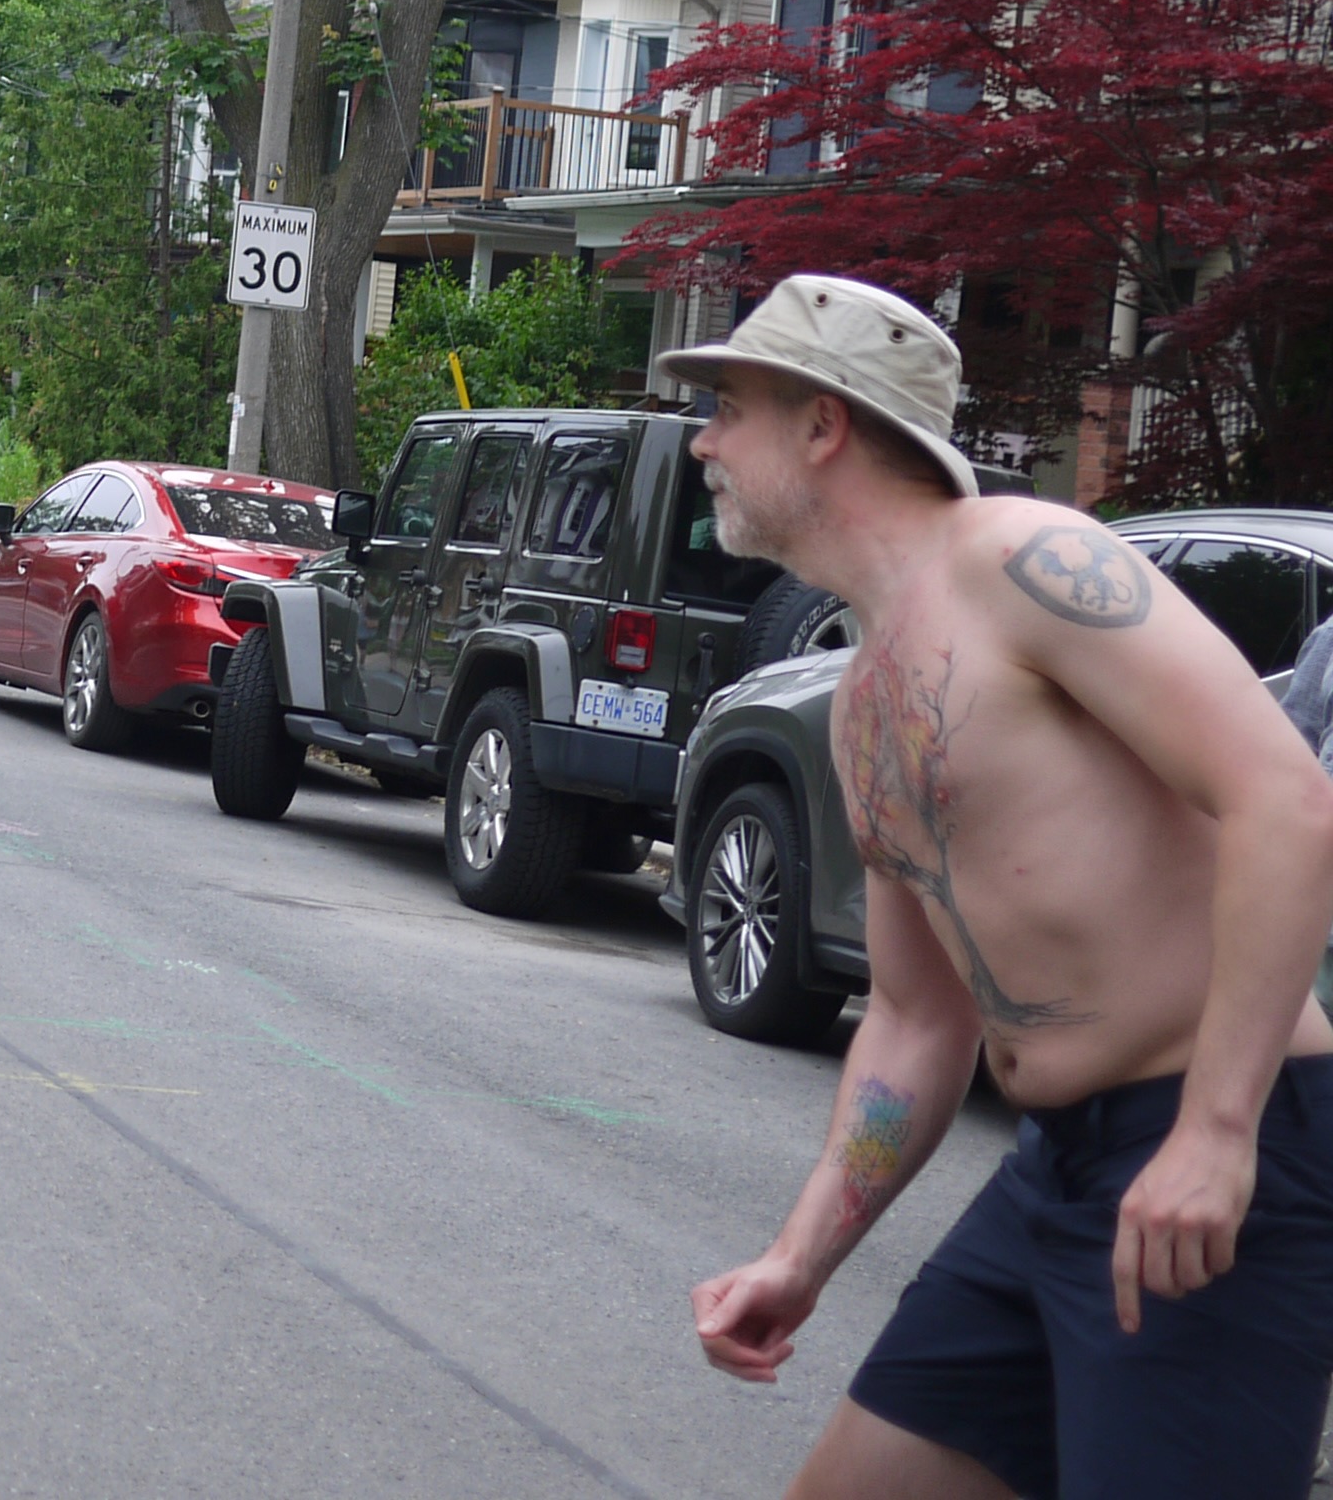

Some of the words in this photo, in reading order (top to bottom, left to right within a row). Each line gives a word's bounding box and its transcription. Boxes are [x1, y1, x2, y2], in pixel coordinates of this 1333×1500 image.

[241, 215, 308, 236] MAXIMUM
[239, 247, 302, 293] 30
[582, 693, 625, 720] CEMW
[634, 700, 663, 726] 564
